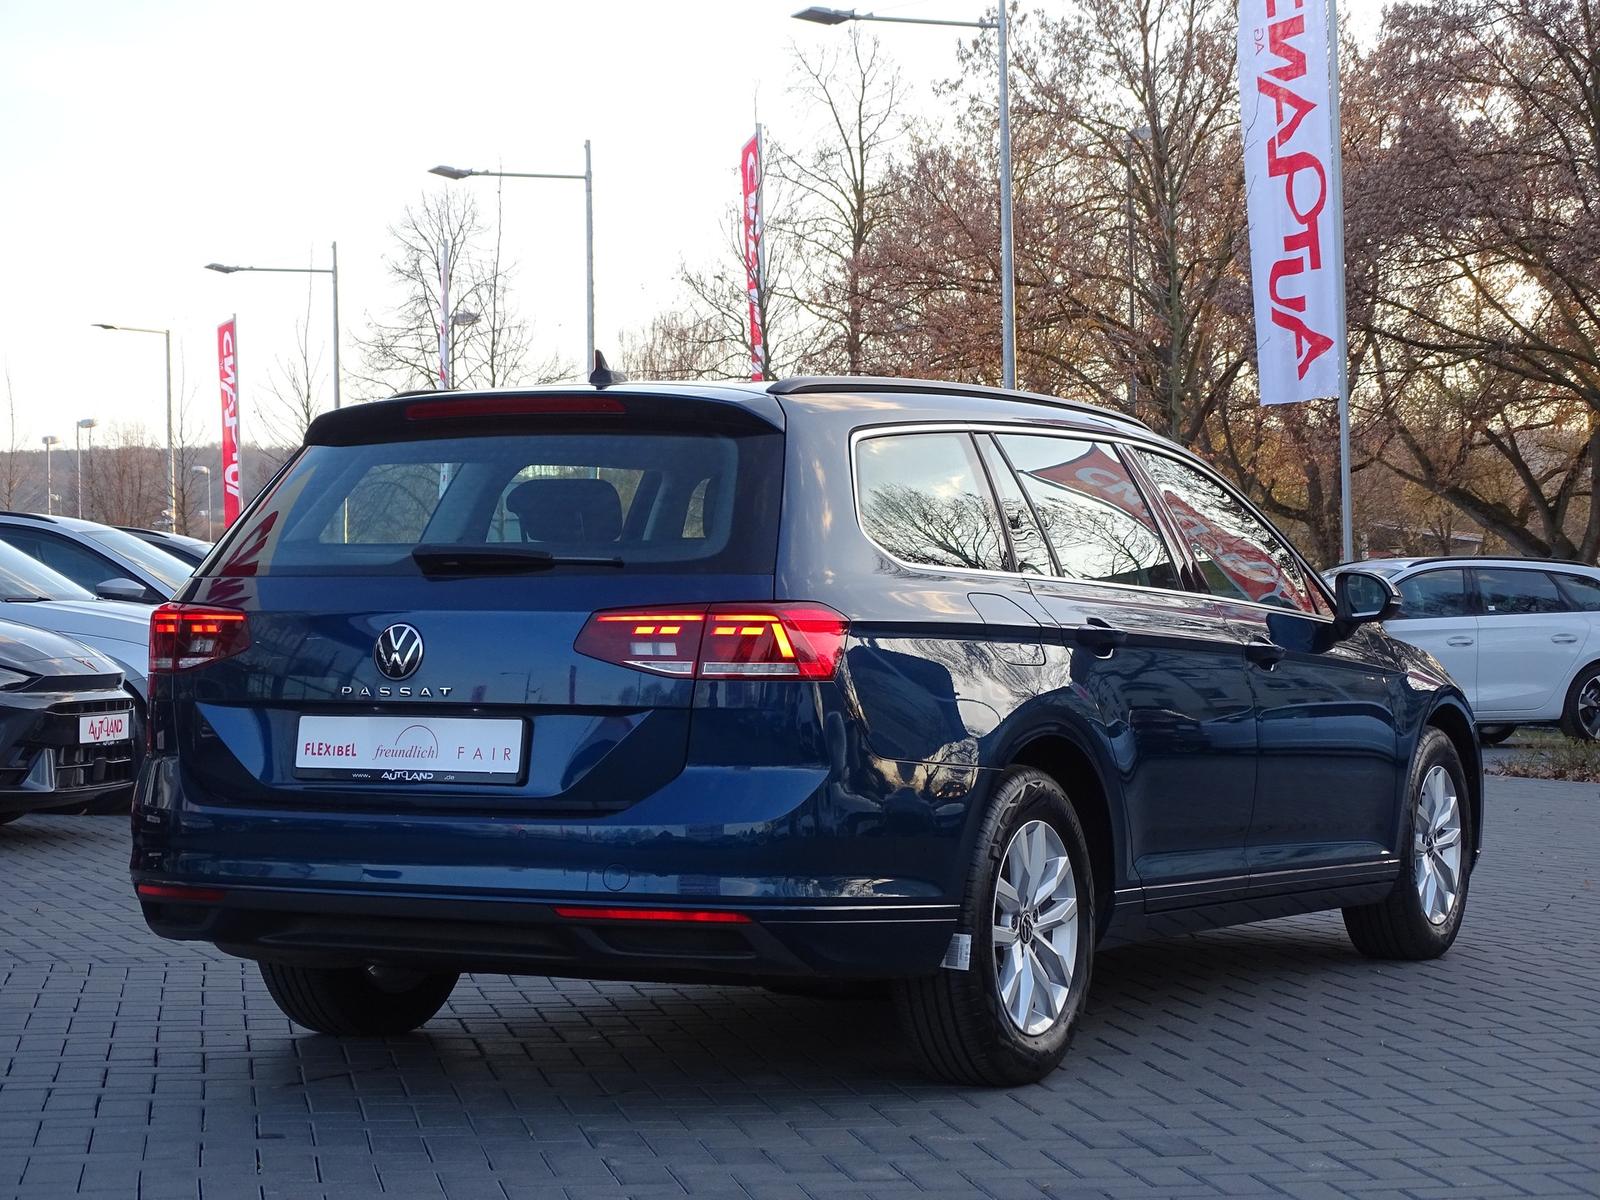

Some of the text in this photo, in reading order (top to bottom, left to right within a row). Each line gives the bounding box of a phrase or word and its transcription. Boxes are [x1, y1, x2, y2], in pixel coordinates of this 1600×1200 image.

[340, 685, 453, 698] PASSAT
[89, 716, 122, 741] AUTOLAND
[304, 742, 512, 761] FLEXIBEL freundlich FAIR
[381, 770, 434, 781] AUTOLAND
